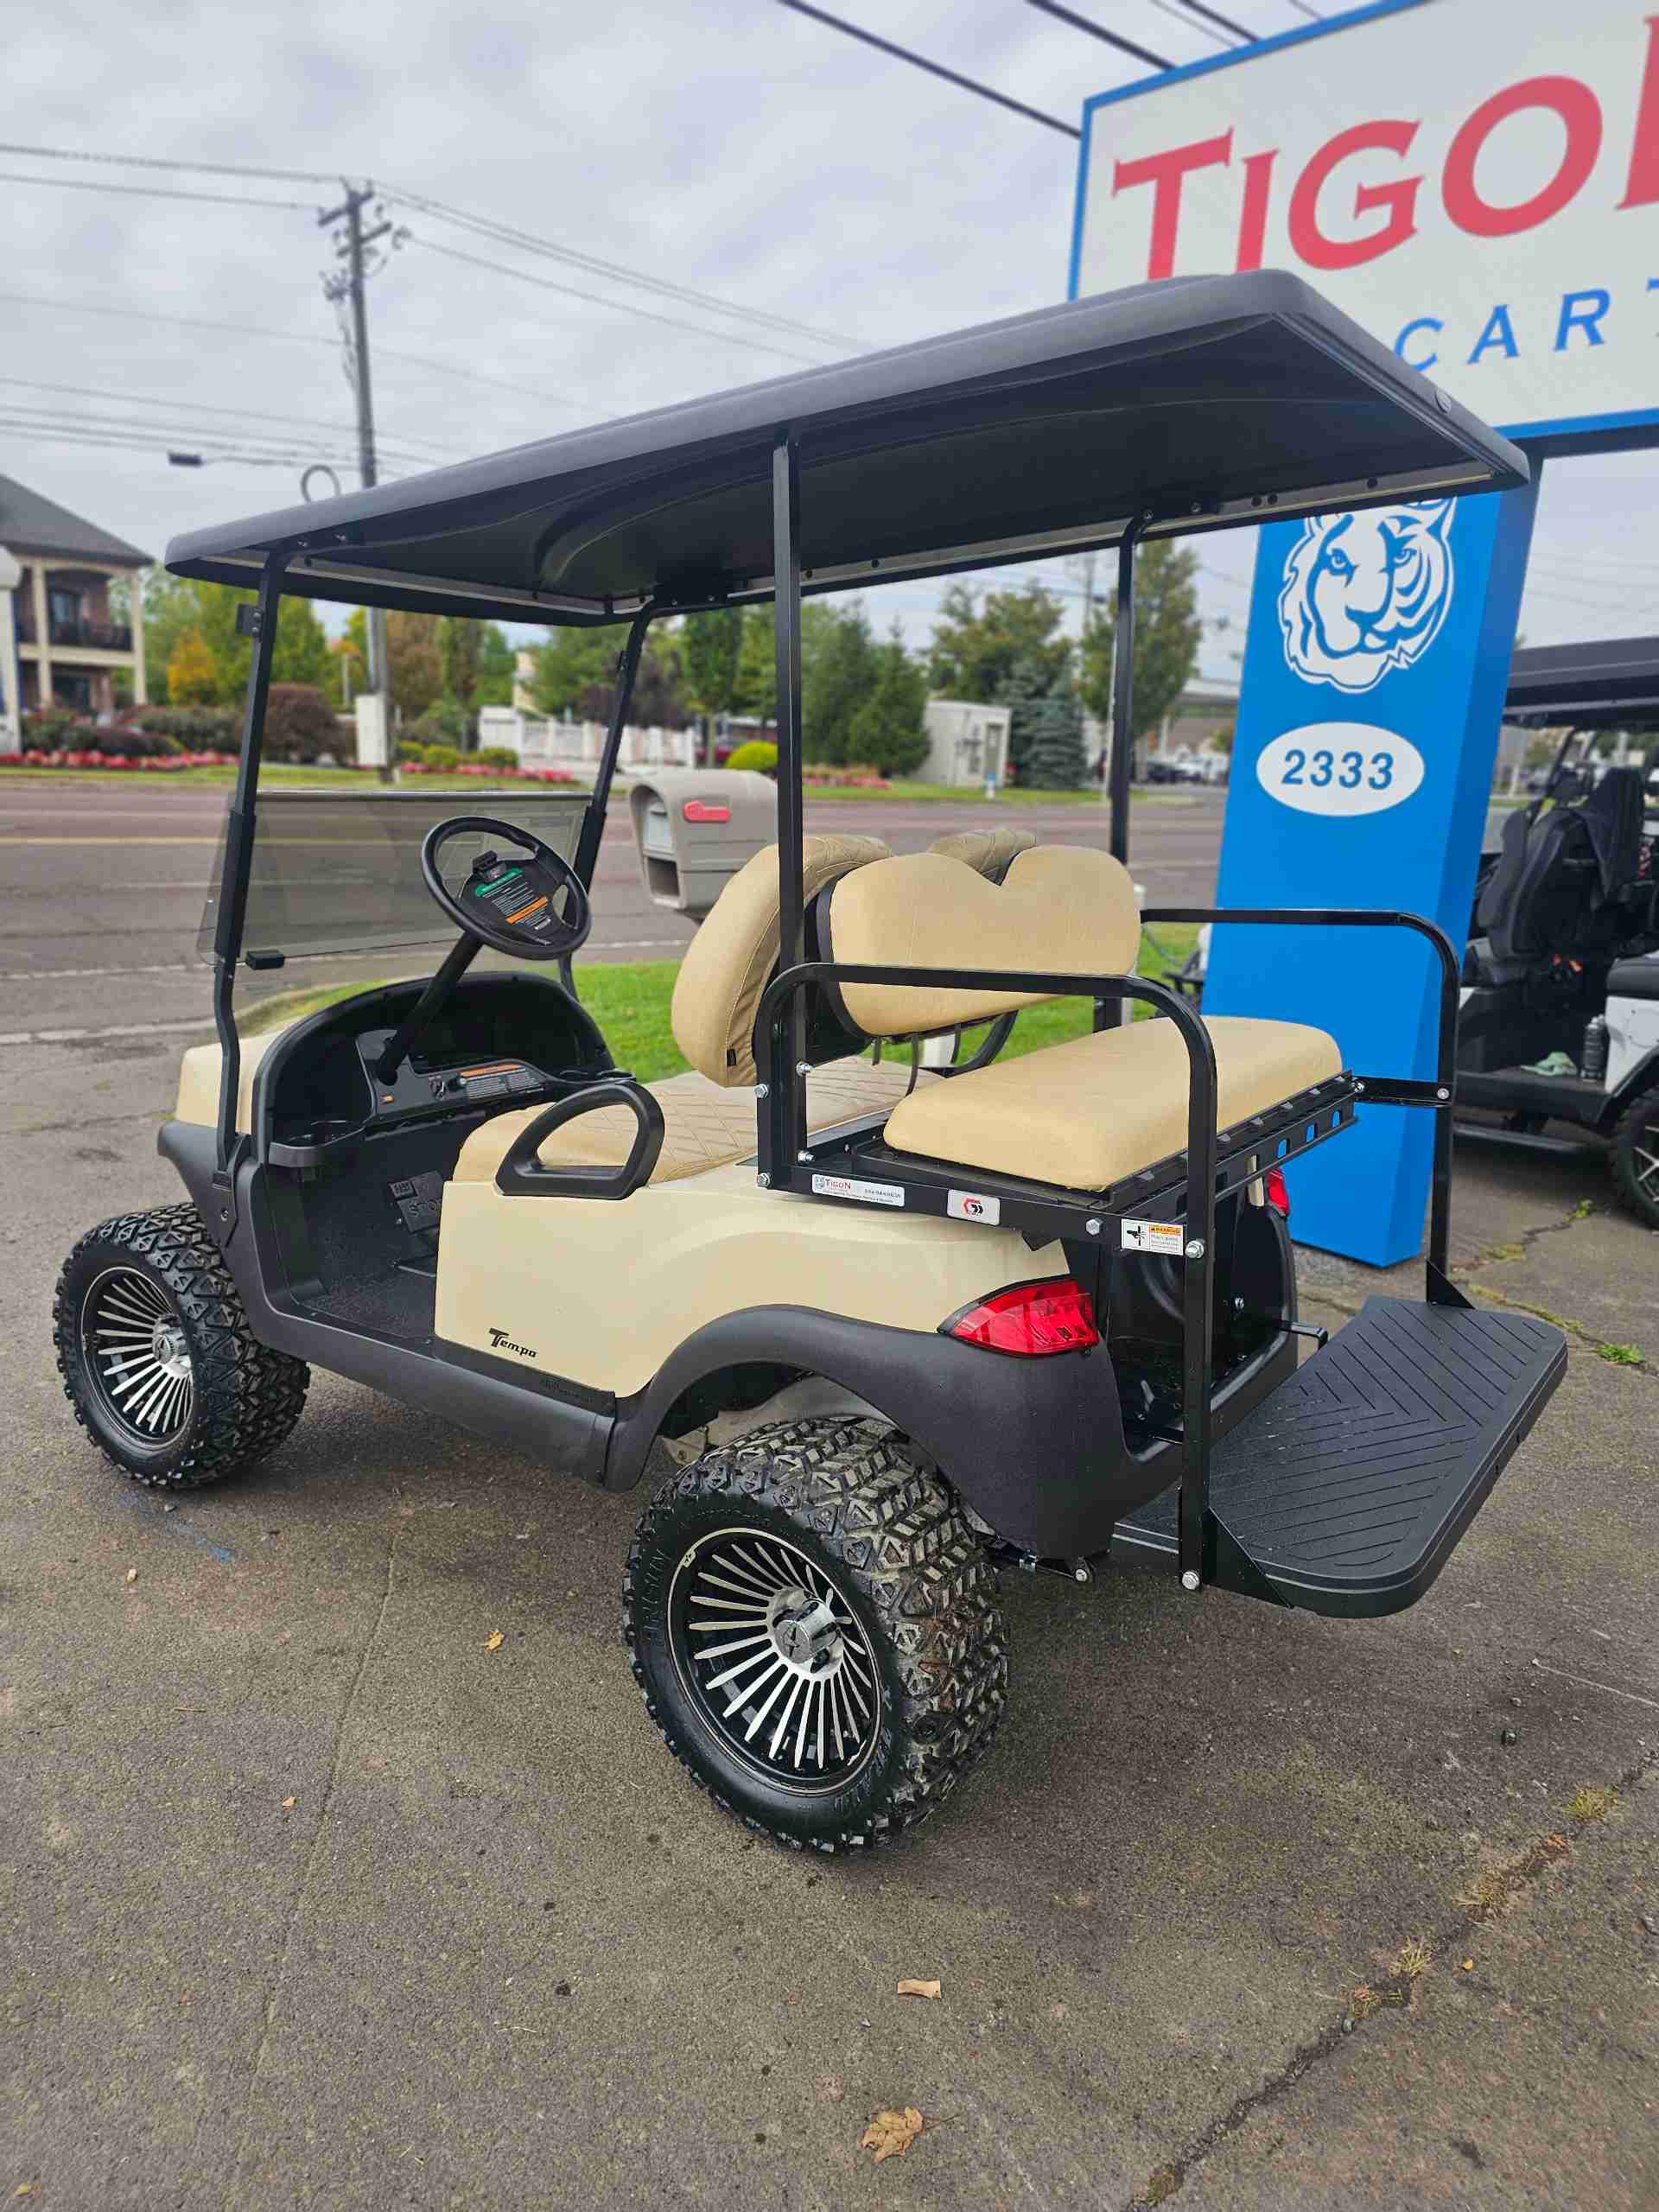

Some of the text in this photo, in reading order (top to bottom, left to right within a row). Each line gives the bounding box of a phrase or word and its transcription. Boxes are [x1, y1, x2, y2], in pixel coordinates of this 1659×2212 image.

[1394, 277, 1659, 372] CAR
[1281, 749, 1394, 790] 2333
[489, 1328, 537, 1357] Tempo
